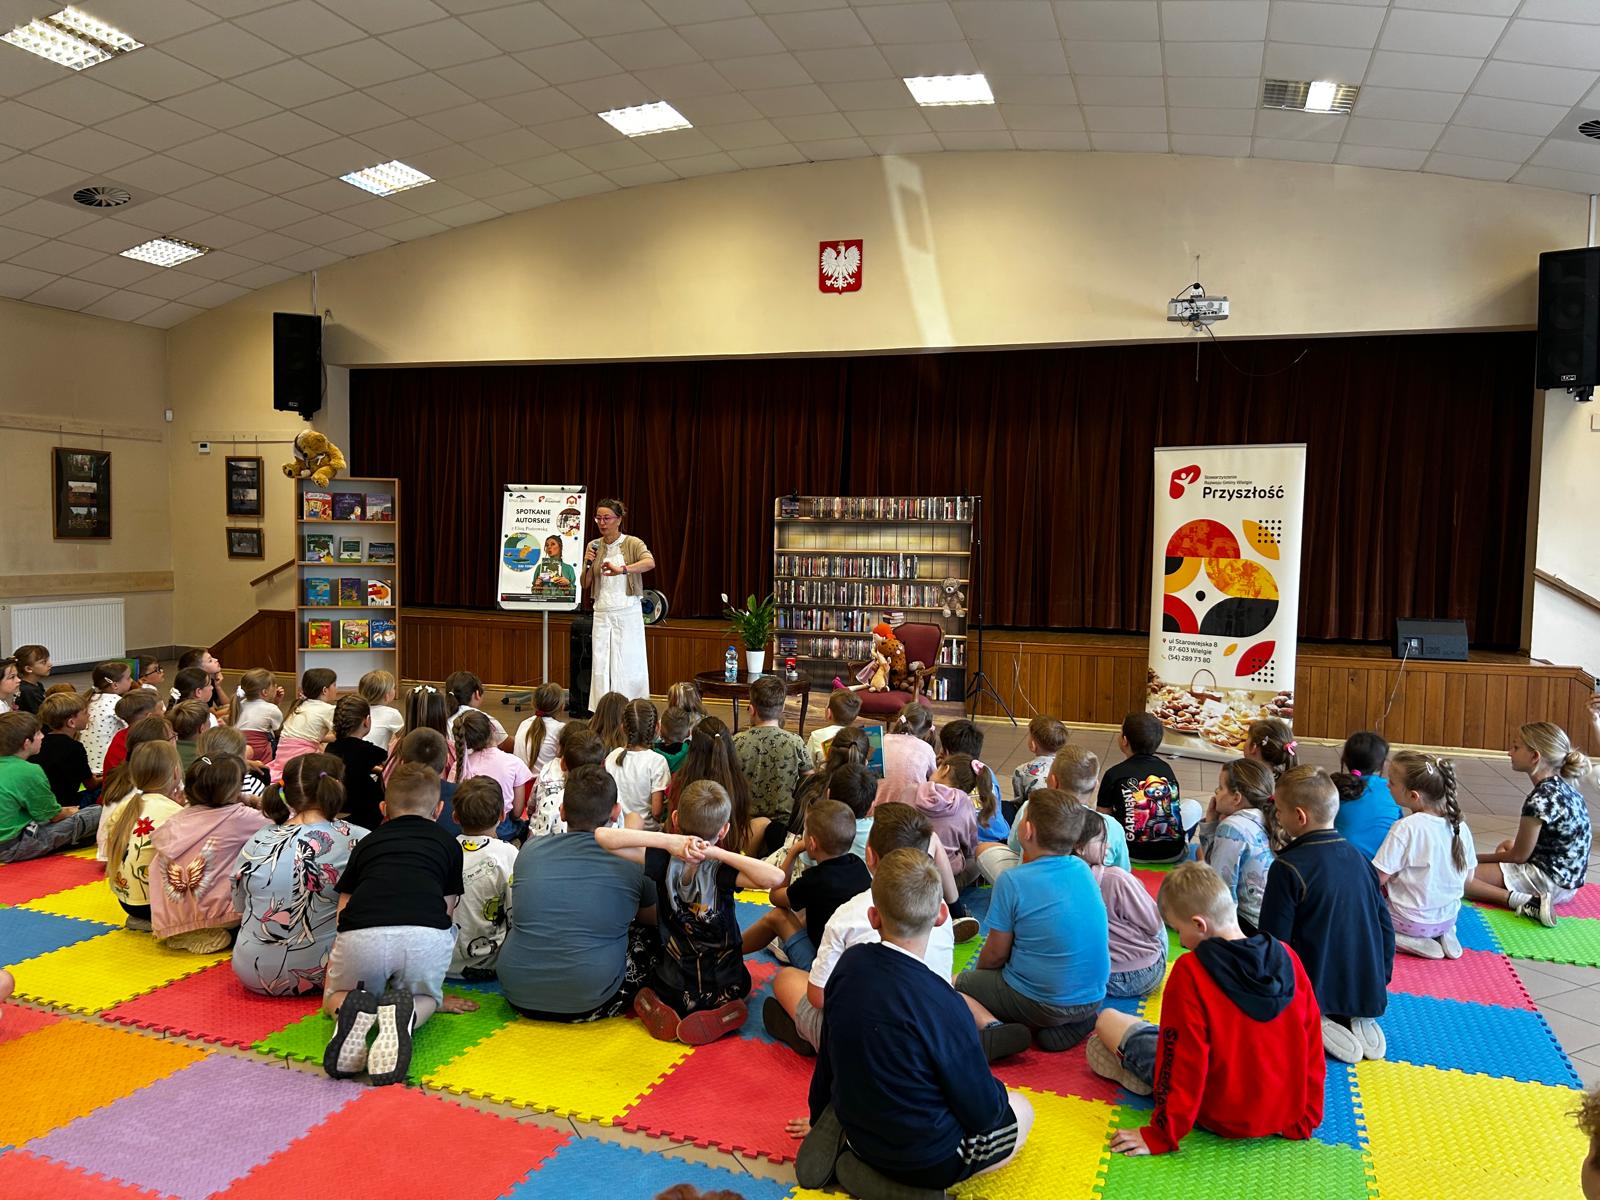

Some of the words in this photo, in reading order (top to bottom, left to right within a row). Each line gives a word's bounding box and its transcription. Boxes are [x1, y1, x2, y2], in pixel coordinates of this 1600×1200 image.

[1202, 485, 1285, 501] Przyszłość
[1175, 639, 1212, 647] Starowiejska
[1190, 647, 1212, 655] Wielgie
[1122, 789, 1135, 841] GARMENT
